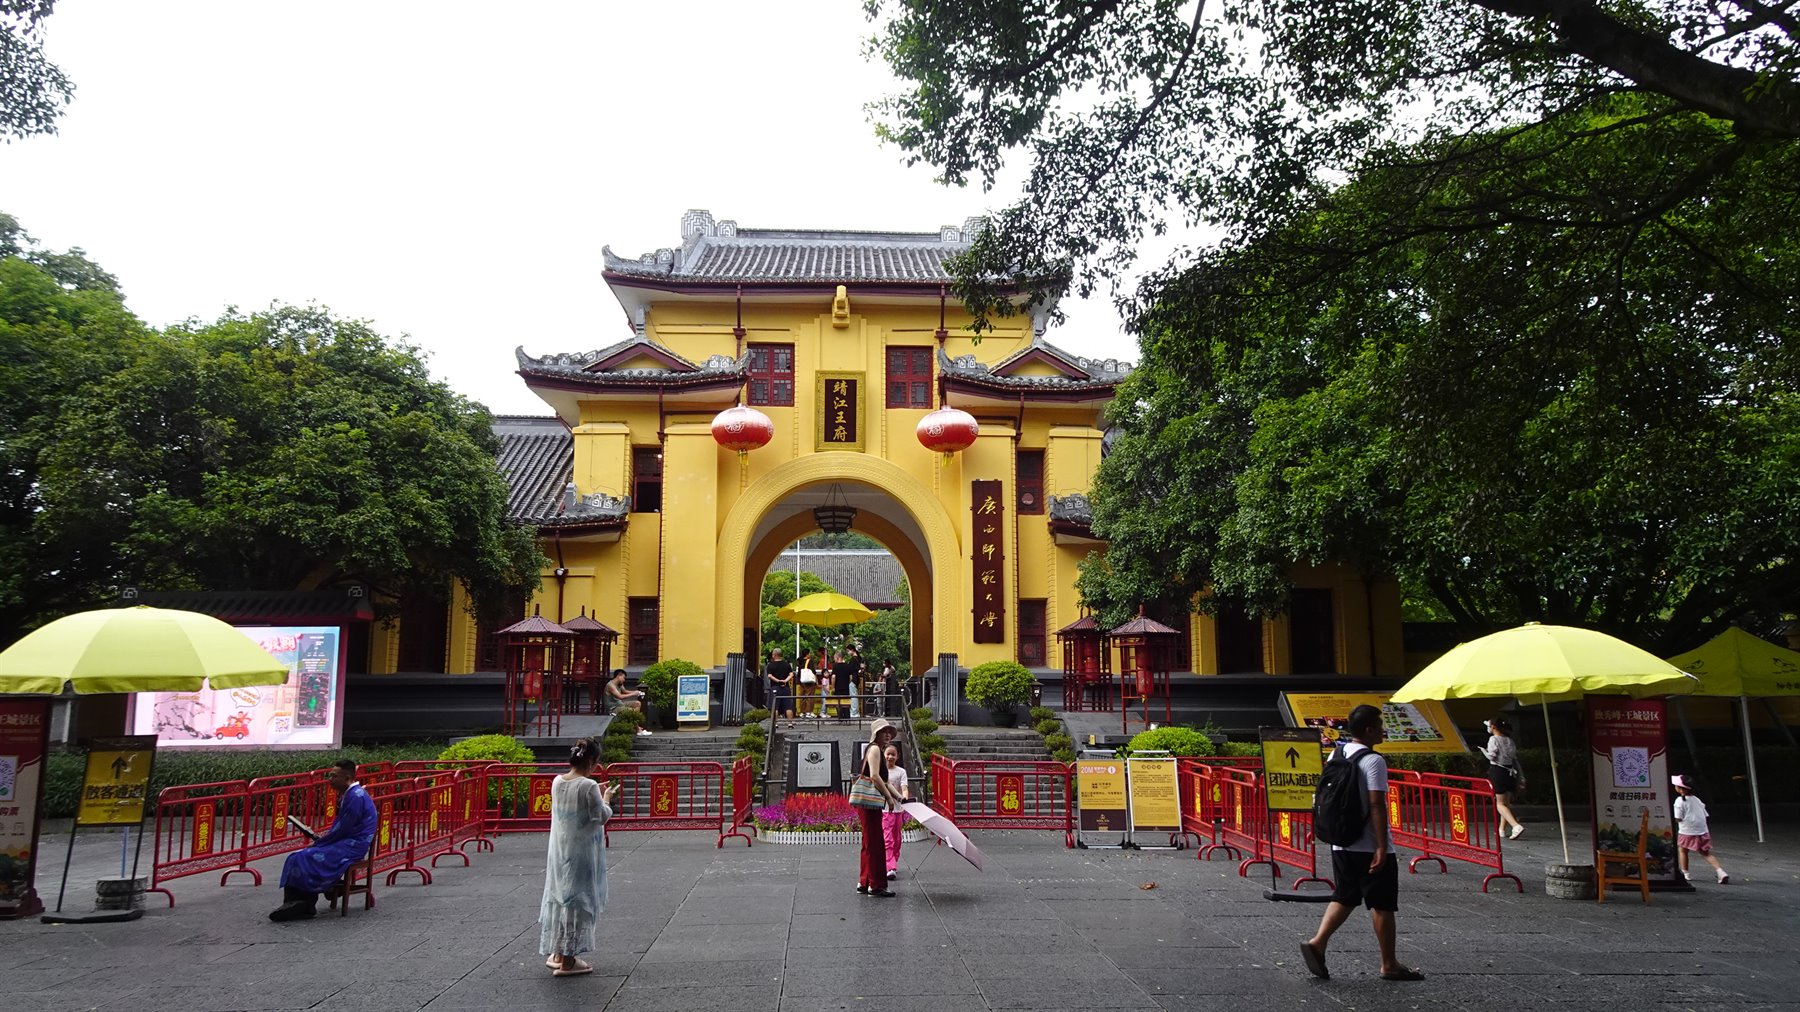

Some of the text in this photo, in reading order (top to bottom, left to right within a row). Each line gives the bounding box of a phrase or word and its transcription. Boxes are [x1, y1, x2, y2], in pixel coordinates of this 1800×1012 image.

[832, 379, 849, 442] 靖江王府
[1269, 772, 1320, 786] 团队通道
[1001, 790, 1019, 810] 福
[1609, 792, 1656, 801] 微信扫码购票
